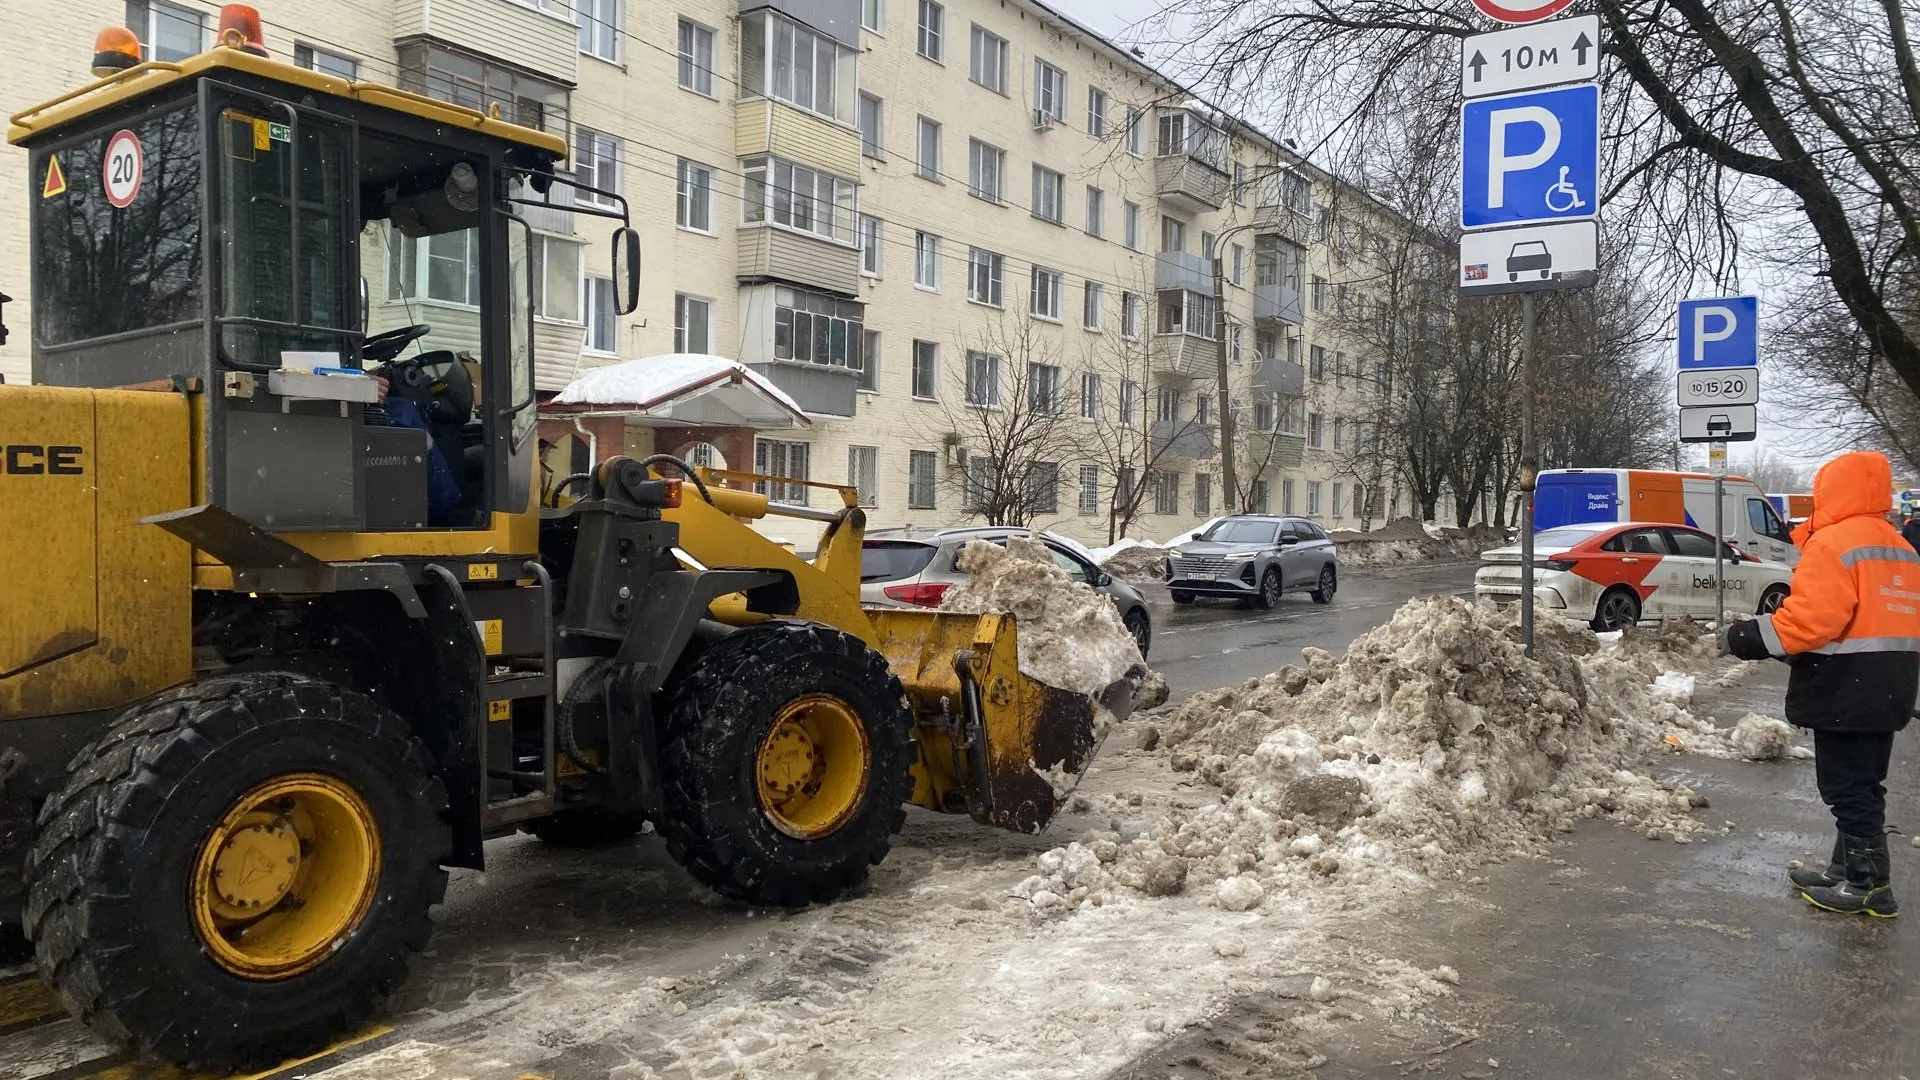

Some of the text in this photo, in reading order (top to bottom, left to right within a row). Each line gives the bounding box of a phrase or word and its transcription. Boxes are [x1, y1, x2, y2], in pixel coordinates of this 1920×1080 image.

[112, 154, 133, 183] 20
[1488, 106, 1562, 208] P
[1694, 306, 1737, 361] P
[1692, 380, 1744, 393] 10 15 20
[0, 445, 83, 474] CE
[1588, 502, 1608, 510] Драйв
